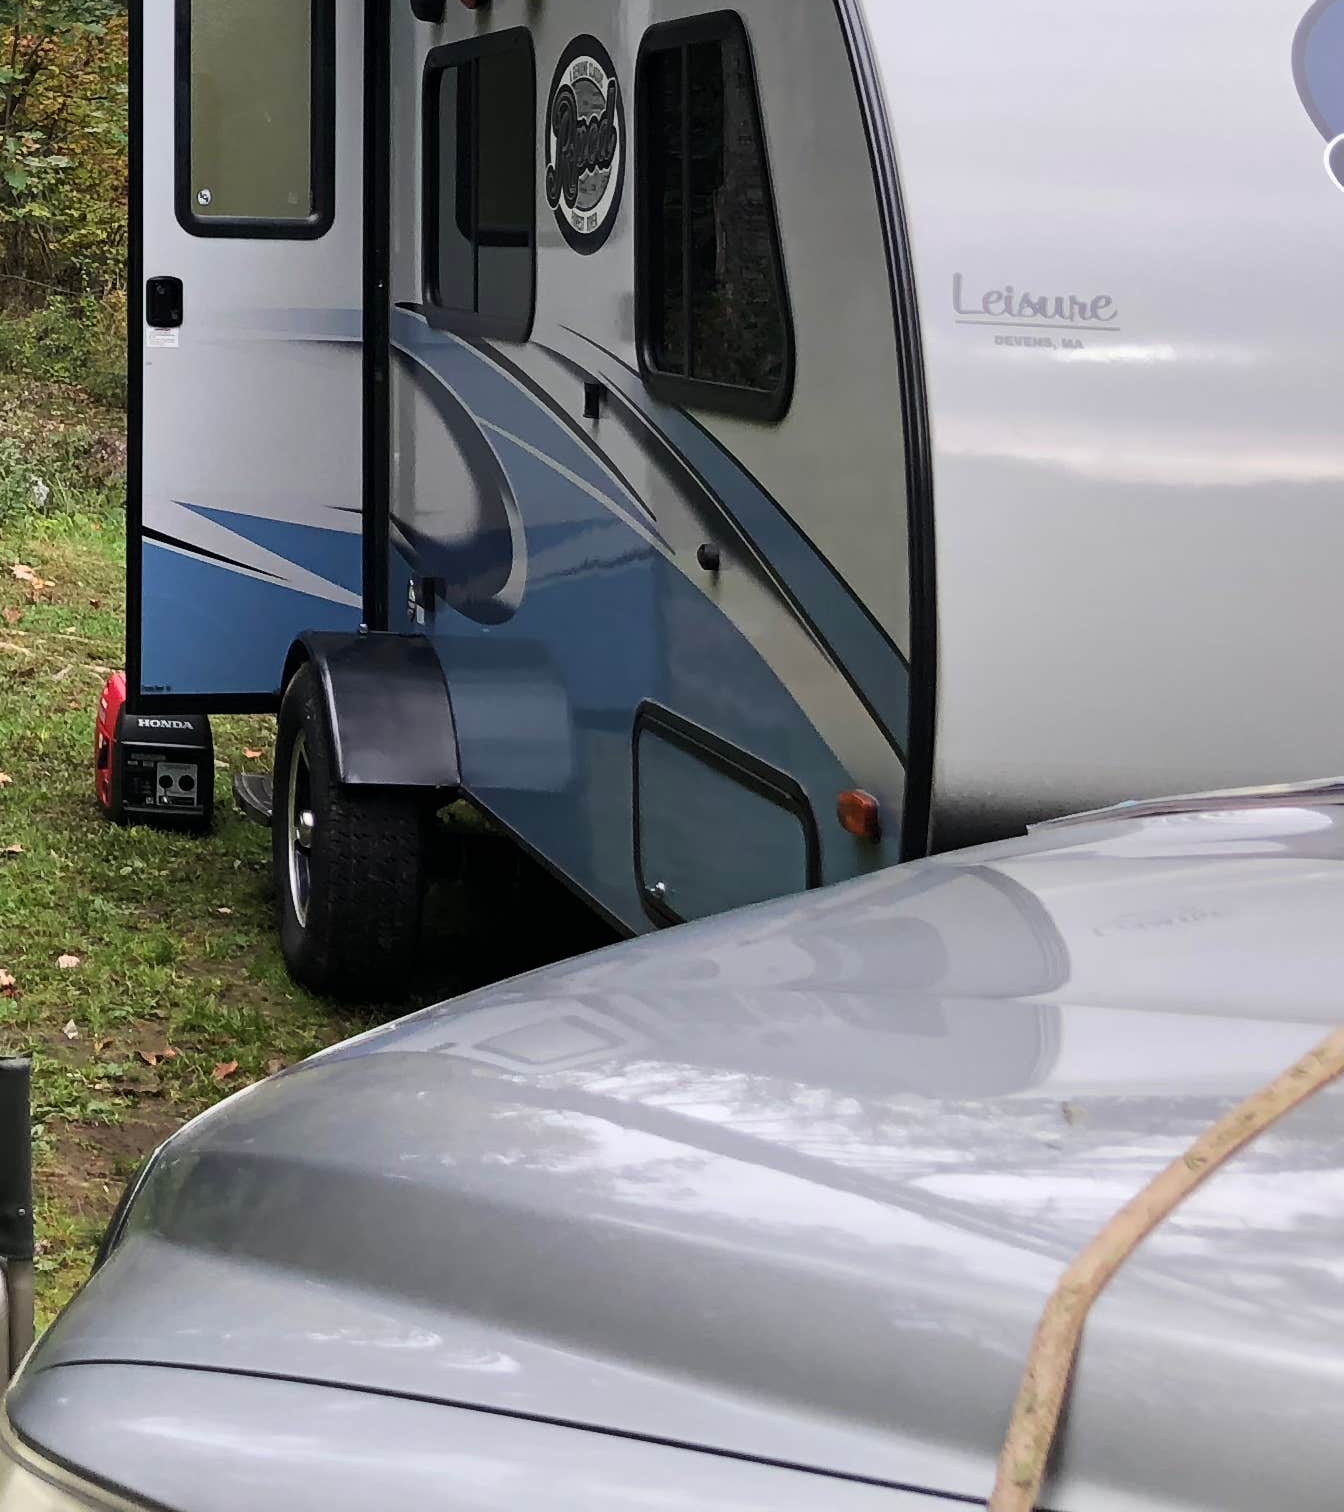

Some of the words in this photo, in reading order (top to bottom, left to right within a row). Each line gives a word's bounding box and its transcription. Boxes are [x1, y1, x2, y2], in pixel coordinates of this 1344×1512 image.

[953, 272, 1118, 322] Leisure
[994, 335, 1058, 350] DEVENS,
[1062, 338, 1084, 350] MA
[138, 719, 194, 730] HONDA
